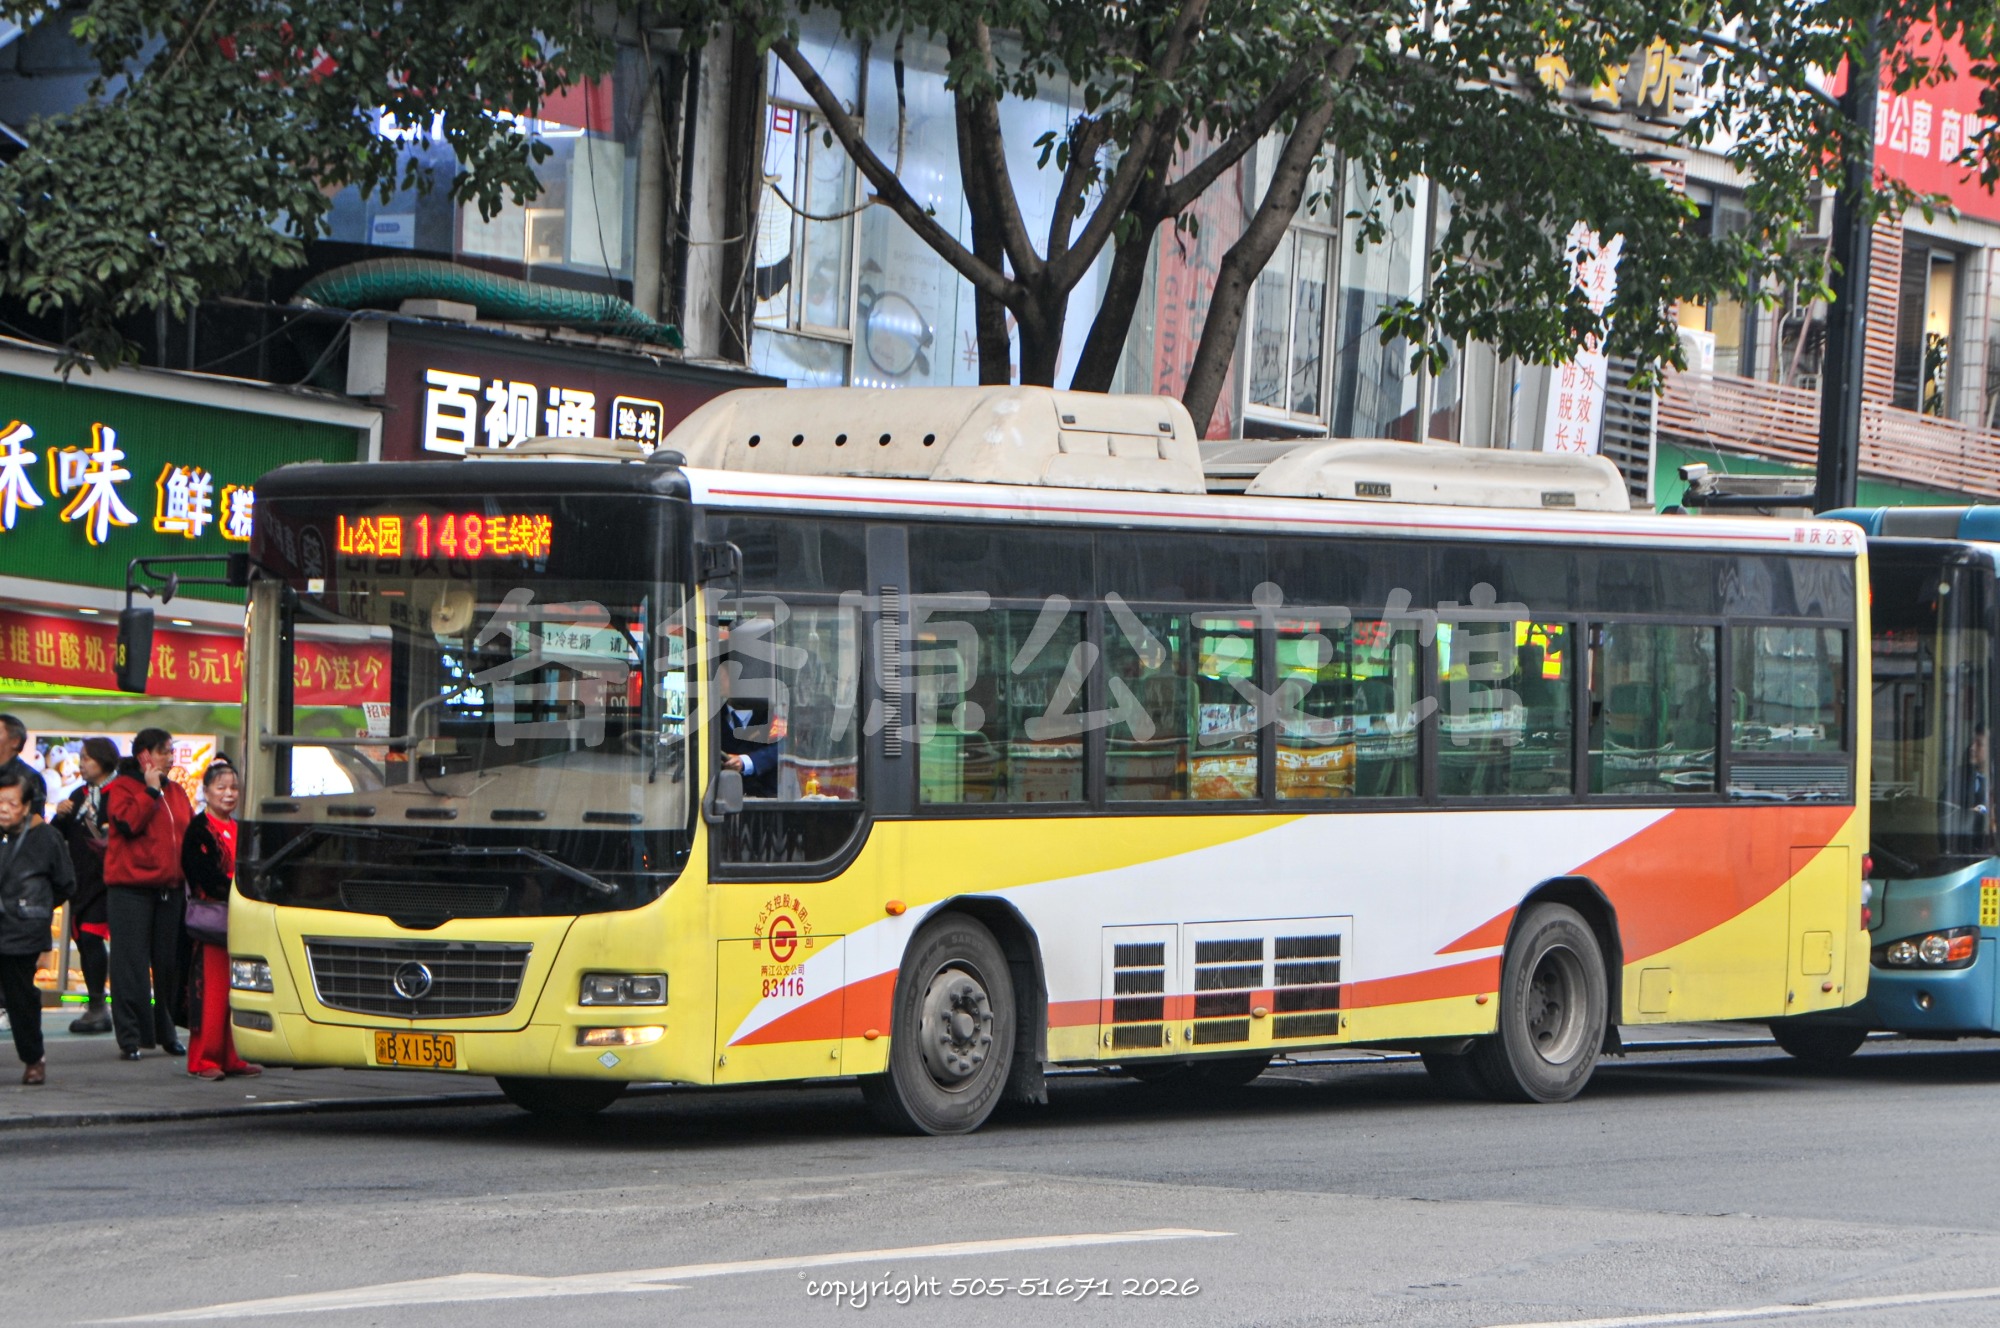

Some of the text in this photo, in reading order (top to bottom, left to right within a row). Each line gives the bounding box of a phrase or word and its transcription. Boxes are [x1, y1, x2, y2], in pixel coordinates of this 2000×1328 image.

[424, 369, 596, 454] 百视通
[618, 408, 656, 439] 验光
[414, 514, 482, 557] 148
[1793, 528, 1853, 545] 重庆公交
[0, 624, 177, 680] 推出酸奶花
[293, 654, 382, 690] 2个送1个
[761, 964, 805, 977] 两江公交公司
[762, 977, 804, 998] 83116
